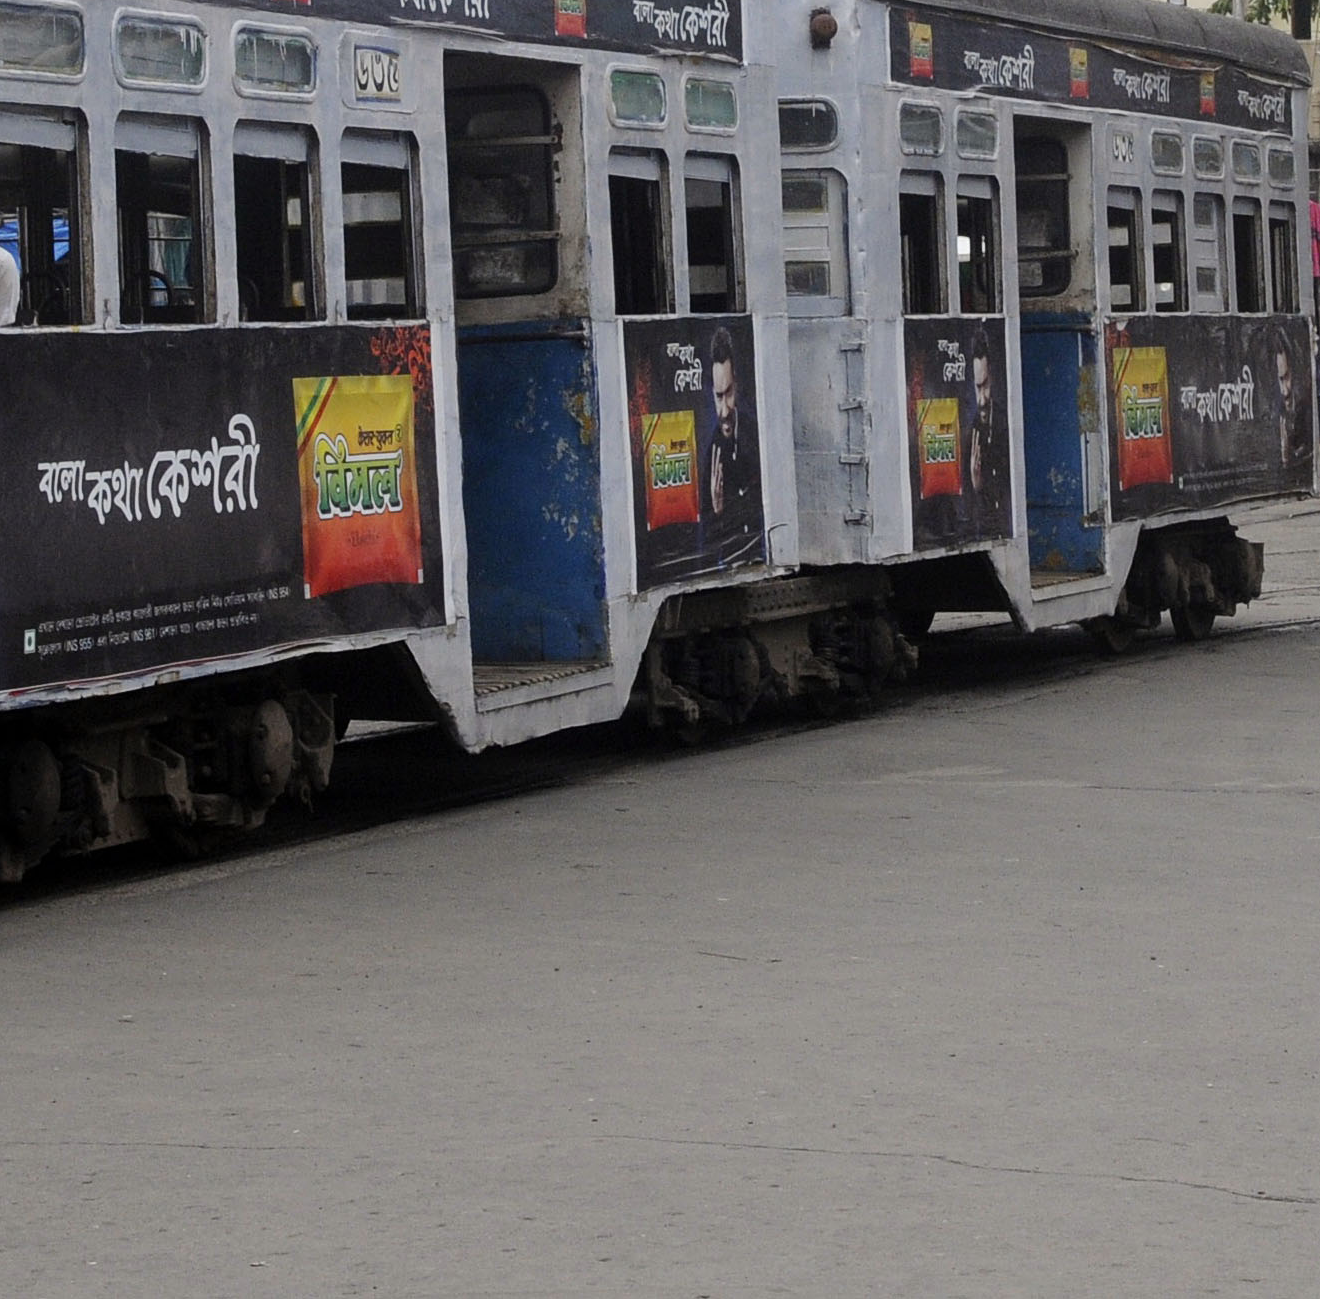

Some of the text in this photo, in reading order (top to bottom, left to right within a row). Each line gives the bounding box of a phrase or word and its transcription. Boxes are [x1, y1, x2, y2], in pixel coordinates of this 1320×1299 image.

[653, 7, 679, 40] কথা
[38, 413, 260, 525] বলো কথা কেশরী
